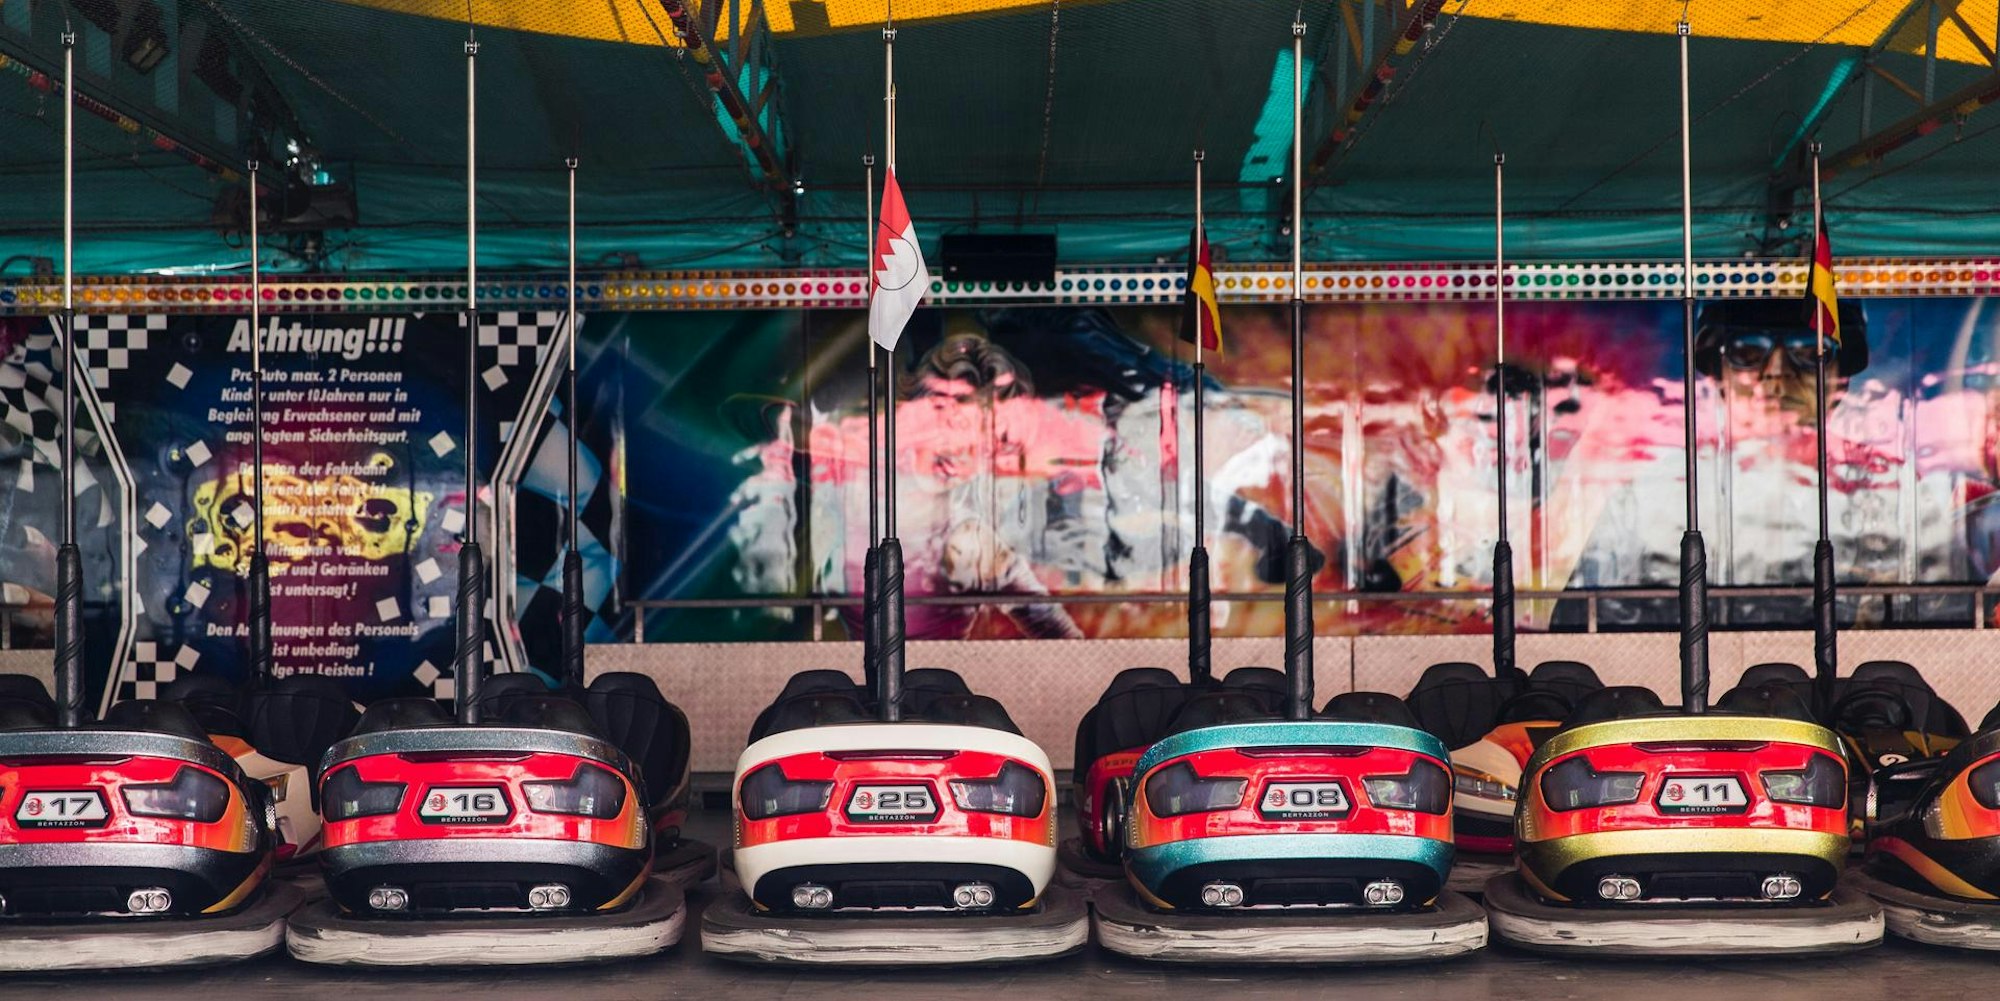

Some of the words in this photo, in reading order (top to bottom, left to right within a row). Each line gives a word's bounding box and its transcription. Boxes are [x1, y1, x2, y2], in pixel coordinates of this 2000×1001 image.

[291, 371, 323, 382] max.
[328, 369, 336, 382] 2
[340, 368, 402, 382] Personen
[268, 390, 304, 402] unter
[368, 391, 391, 402] nur
[395, 388, 408, 402] in
[283, 407, 365, 422] Erwachsener
[369, 407, 394, 422] und
[398, 407, 421, 422] mit
[299, 461, 321, 476] der
[325, 461, 387, 476] Fahrbahn
[291, 561, 318, 576] und
[320, 561, 389, 576] Getränken
[285, 583, 349, 599] untersagt
[207, 623, 232, 636] Den
[328, 622, 351, 636] des
[355, 622, 419, 636] Personals
[272, 643, 289, 657] ist
[292, 643, 360, 659] unbedingt
[317, 663, 365, 677] Leisten
[368, 662, 374, 677] !
[1290, 788, 1340, 807] 08
[1693, 783, 1730, 802] 11
[49, 797, 94, 816] 17
[452, 793, 496, 812] 16
[877, 791, 927, 810] 25
